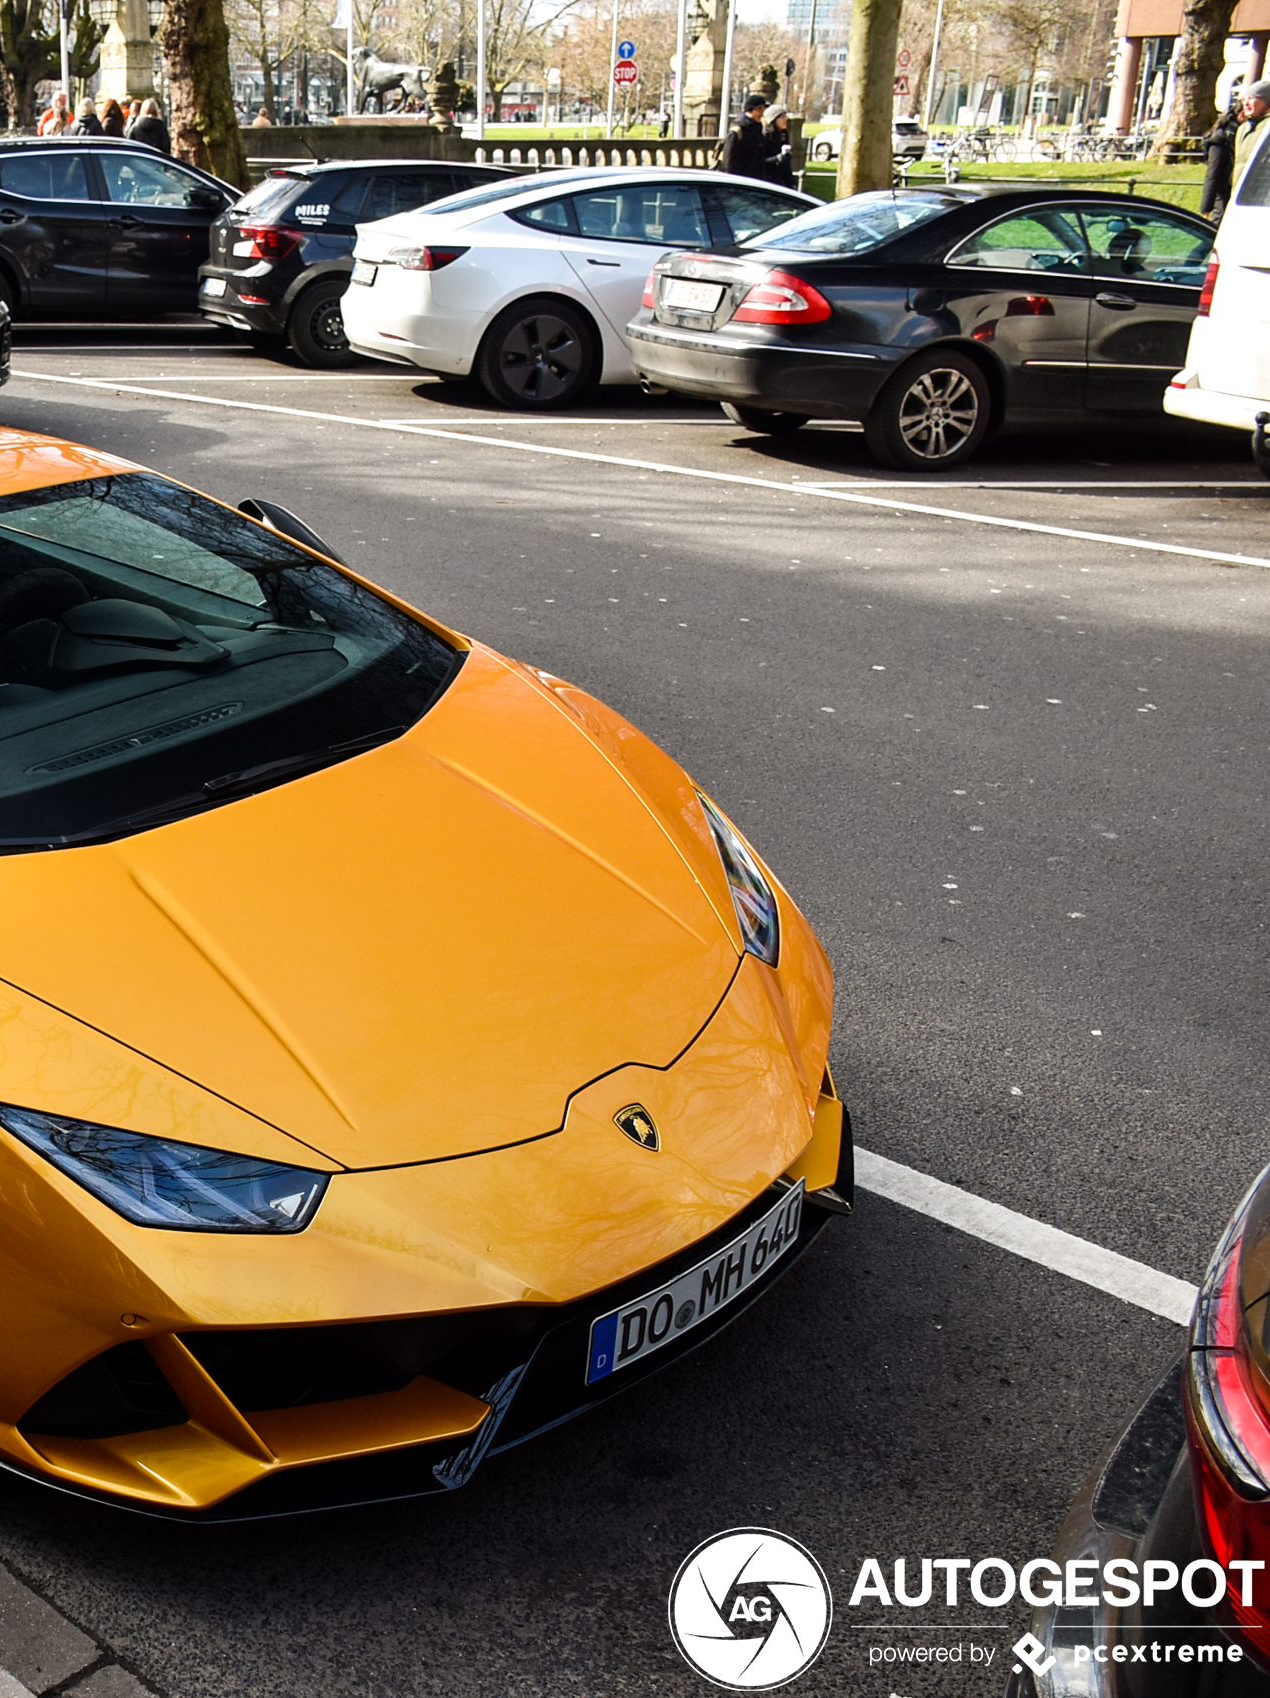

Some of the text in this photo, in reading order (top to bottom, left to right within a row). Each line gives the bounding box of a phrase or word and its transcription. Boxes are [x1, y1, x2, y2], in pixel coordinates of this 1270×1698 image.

[615, 67, 636, 80] STOP
[295, 204, 330, 217] MILES
[596, 1191, 803, 1369] D DO MH 640
